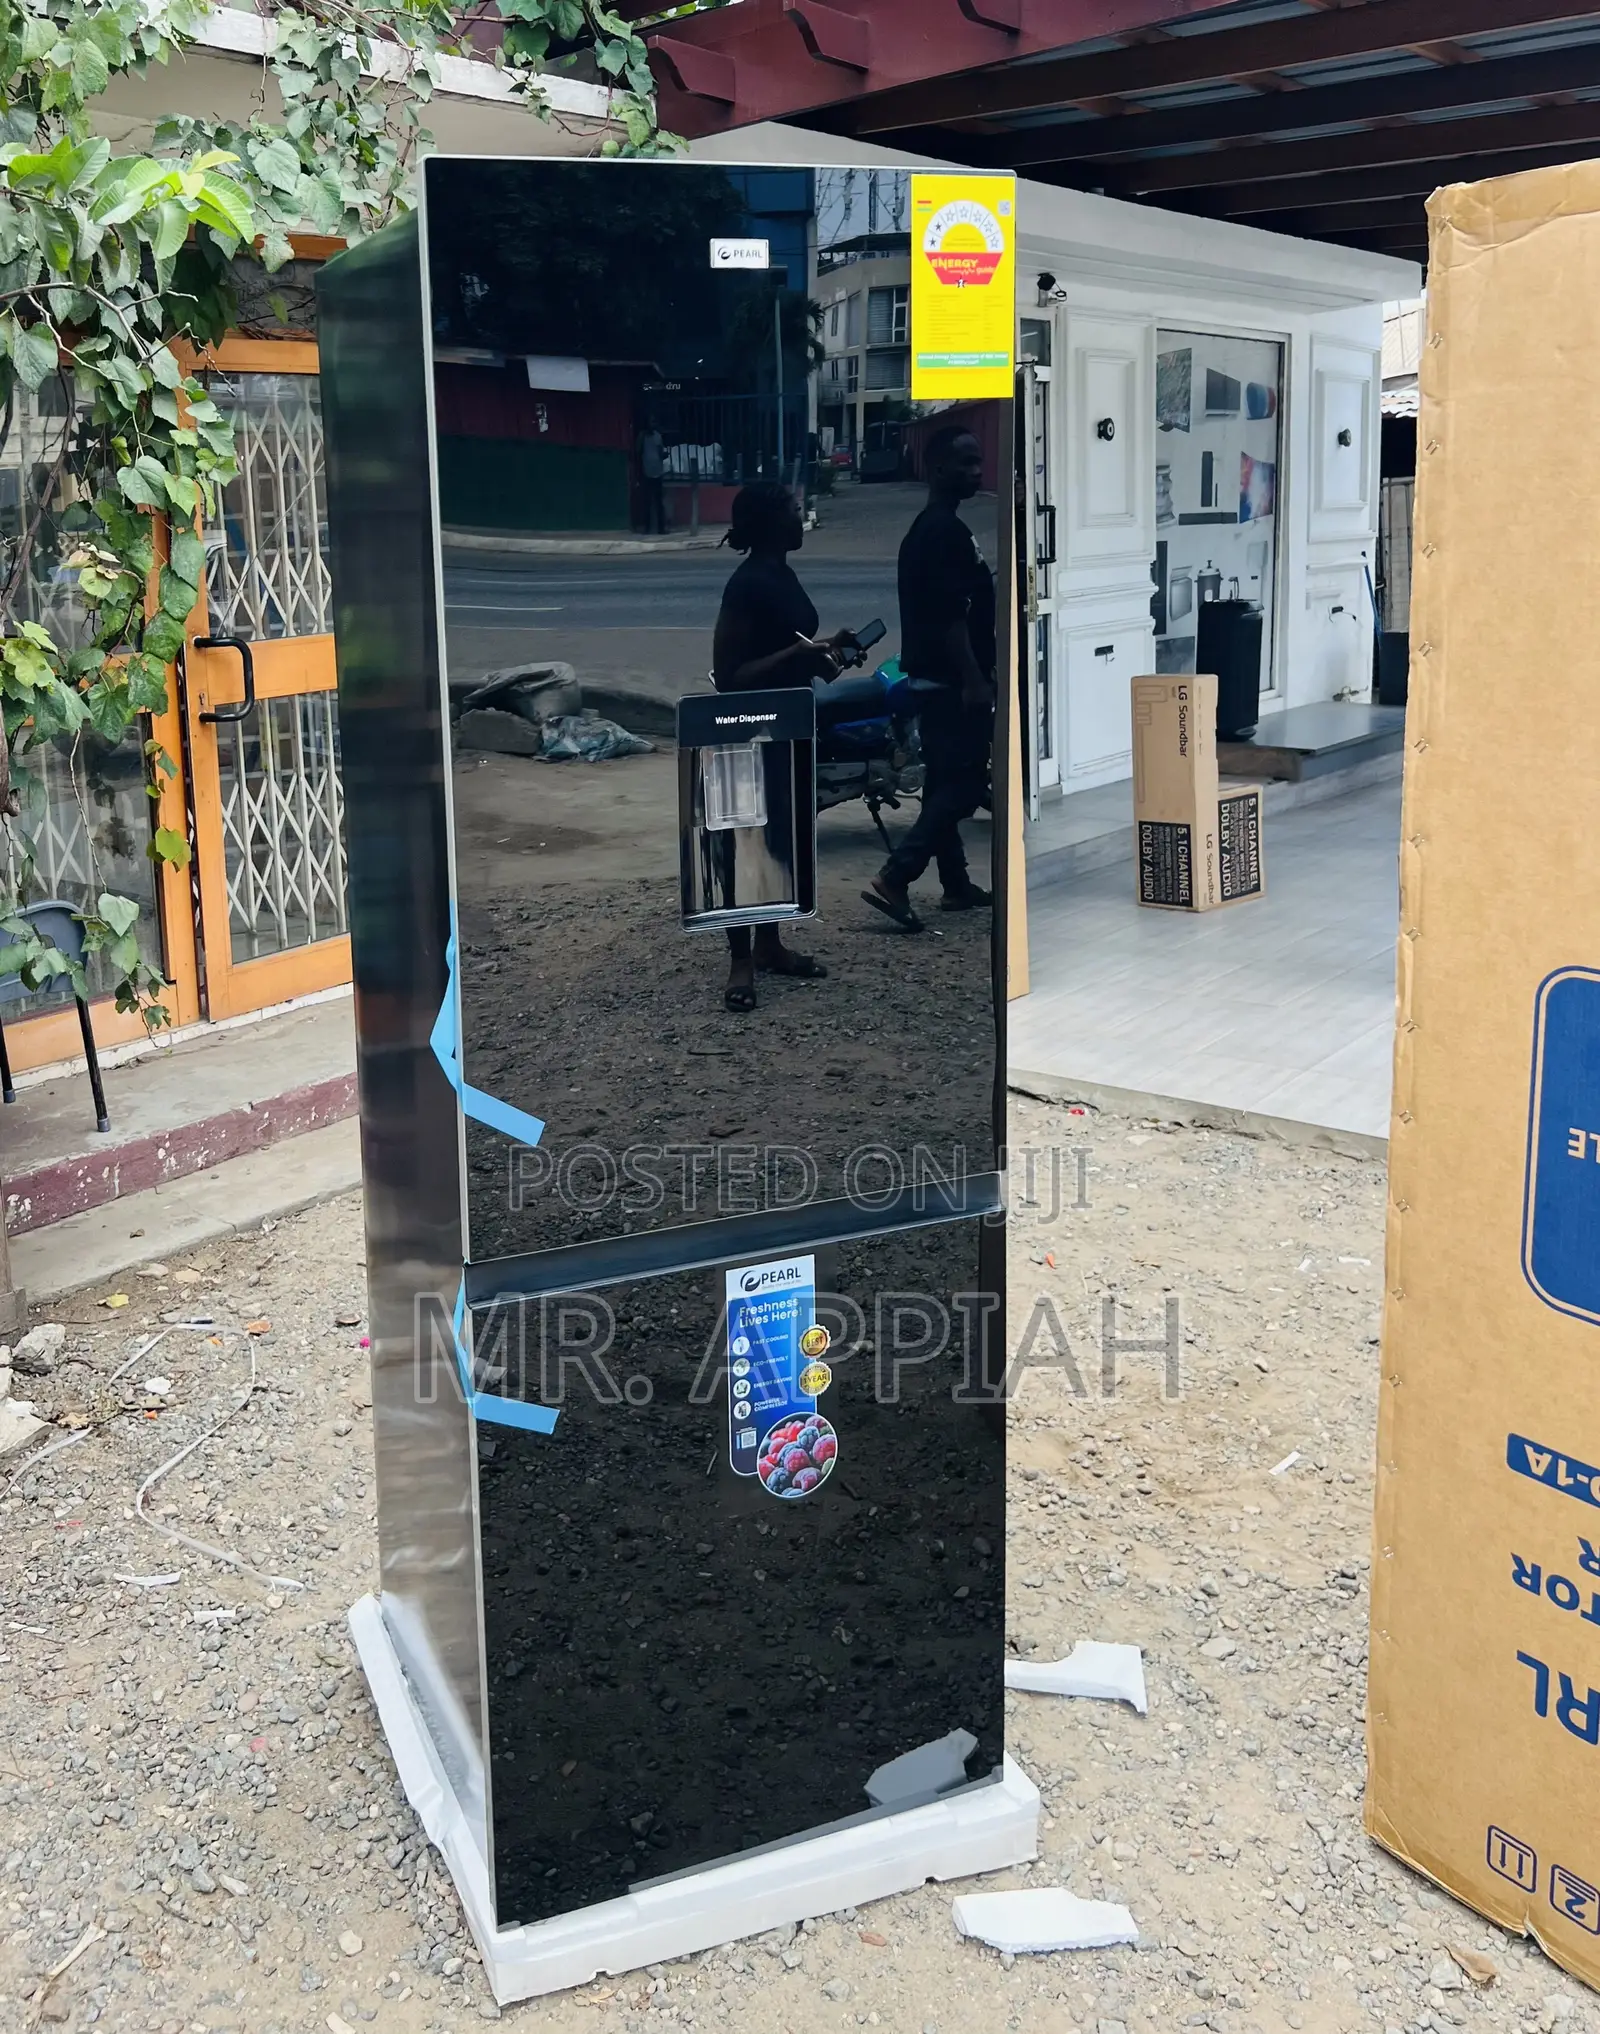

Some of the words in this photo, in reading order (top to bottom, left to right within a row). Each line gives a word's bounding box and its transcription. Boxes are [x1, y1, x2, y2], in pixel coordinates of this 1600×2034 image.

[733, 249, 764, 258] PEARL
[930, 258, 978, 270] ENERGY
[1178, 685, 1188, 701] LG
[715, 716, 738, 724] Water
[739, 714, 777, 723] Dispenser
[1178, 705, 1188, 757] Soundbar
[1221, 803, 1230, 849] DOLBY
[1142, 824, 1152, 862] DOLBY
[1206, 833, 1213, 849] LG
[1143, 864, 1153, 899] AUDIO
[1206, 853, 1214, 905] Soundbar
[1222, 852, 1231, 897] AUDIO
[761, 1267, 802, 1285] PEARL
[740, 1298, 799, 1317] Freshness
[740, 1315, 769, 1328] Lives
[771, 1307, 803, 1322] Here!
[806, 1337, 824, 1348] BEST
[1516, 1650, 1600, 1746] RL
[1564, 1886, 1587, 1921] 2
